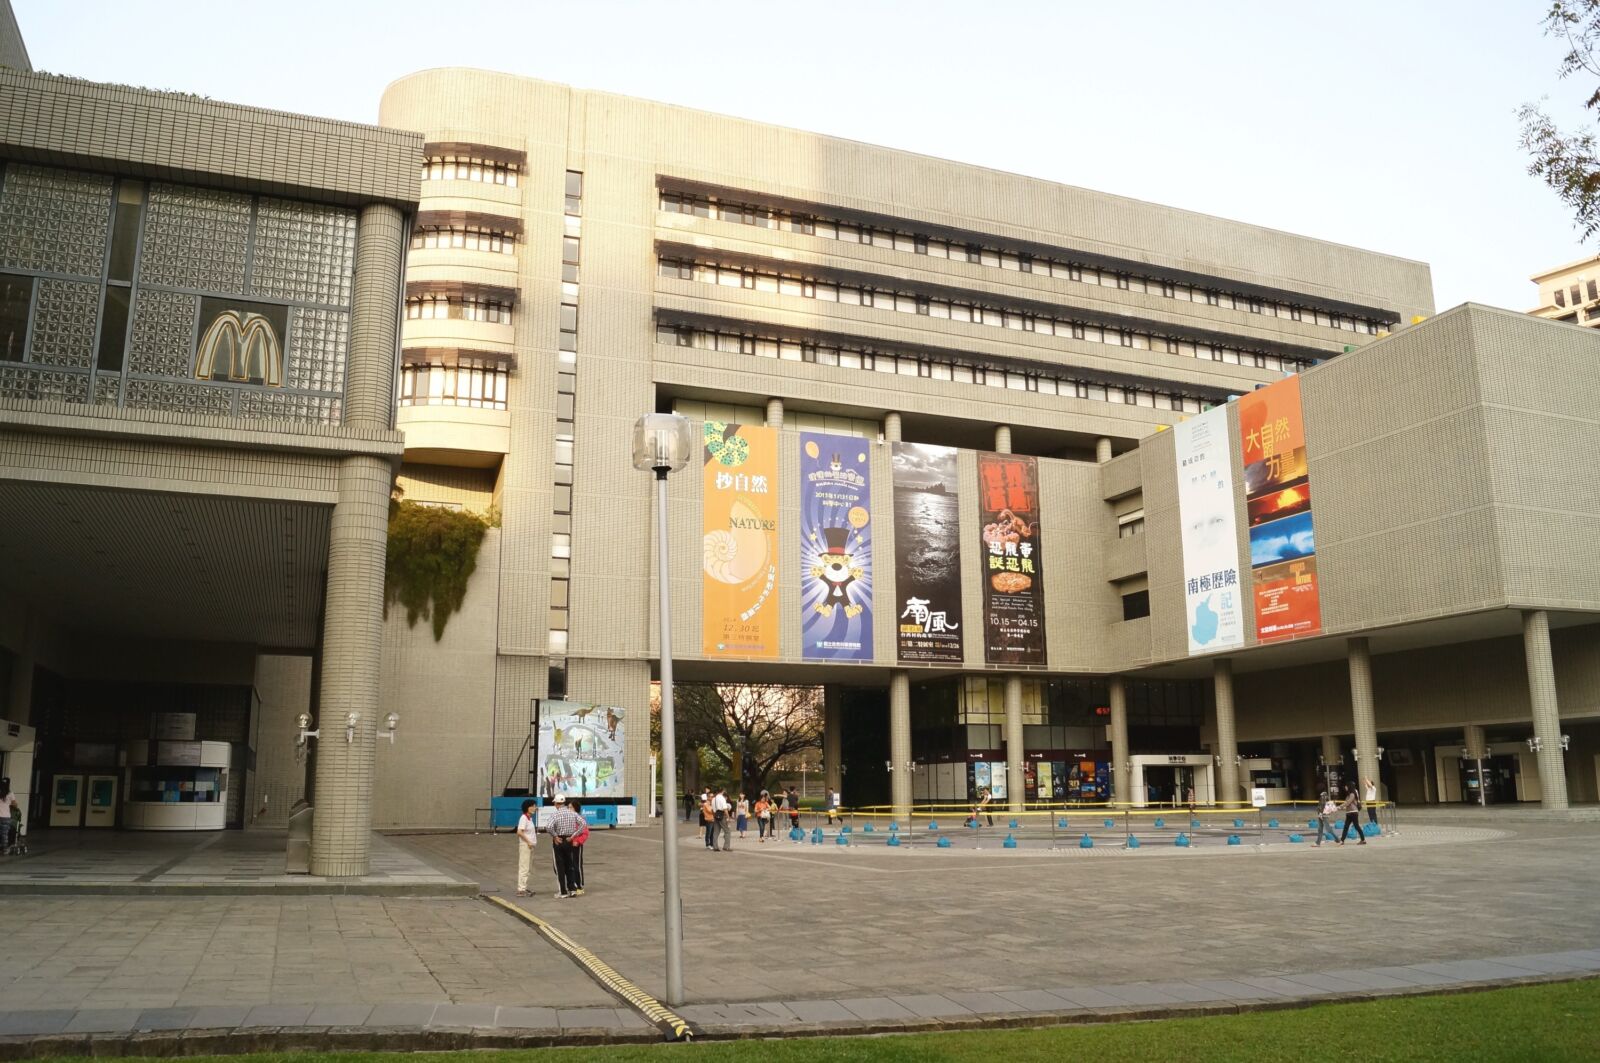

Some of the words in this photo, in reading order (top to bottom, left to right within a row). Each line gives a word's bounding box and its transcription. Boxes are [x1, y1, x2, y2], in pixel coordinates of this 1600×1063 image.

[715, 471, 768, 493] 抄自然
[729, 517, 776, 531] NATURE
[989, 541, 1033, 558] 恐龍蛋
[989, 556, 1036, 573] 誕恐龍
